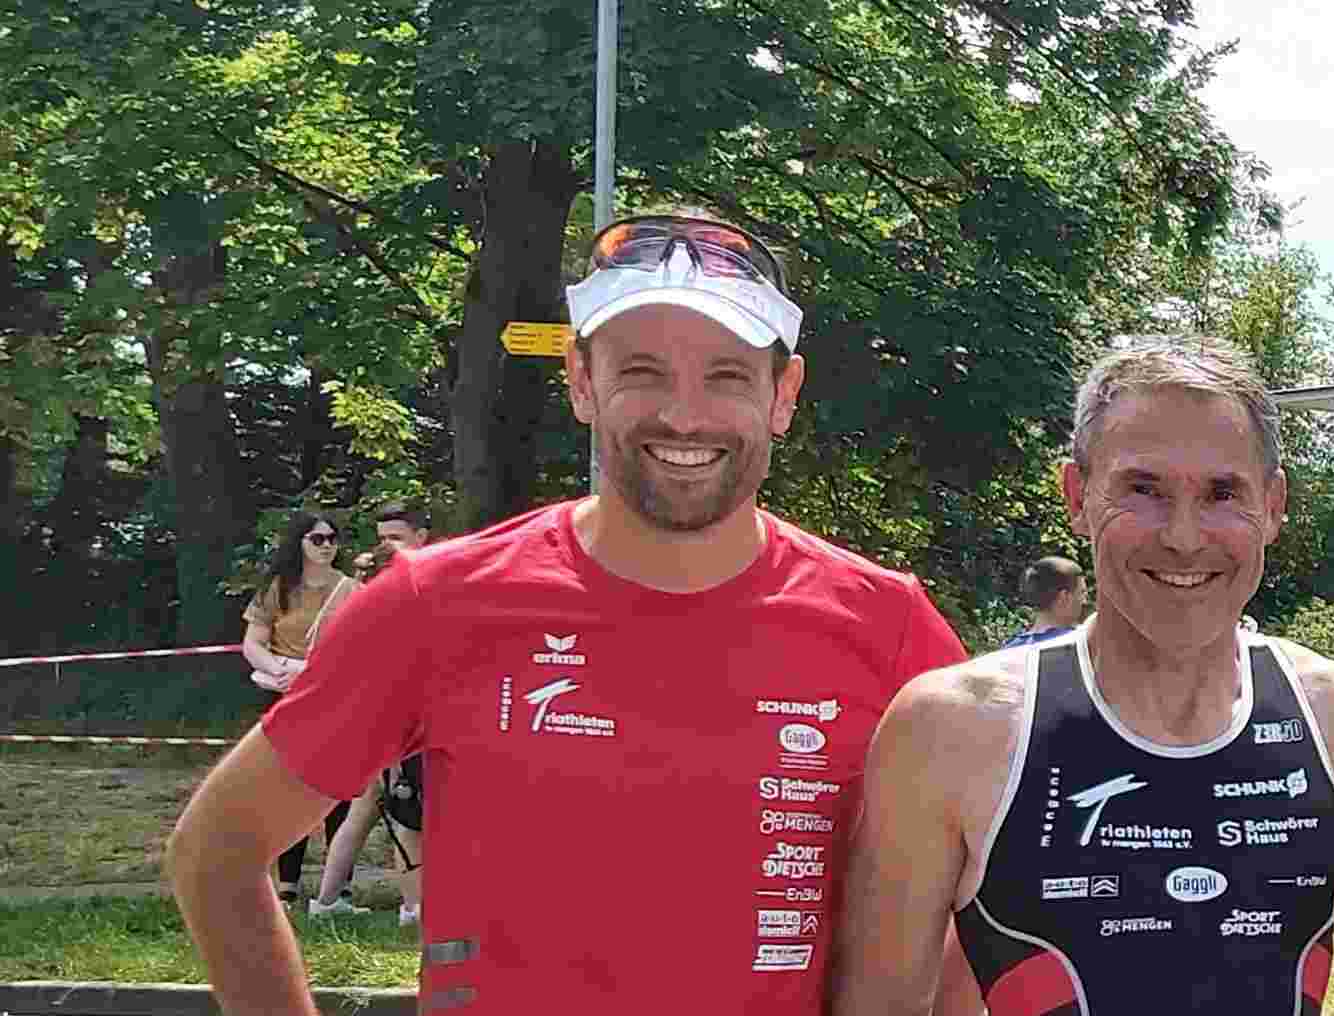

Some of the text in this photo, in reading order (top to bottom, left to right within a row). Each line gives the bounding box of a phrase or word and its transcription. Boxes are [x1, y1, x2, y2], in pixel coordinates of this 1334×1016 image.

[757, 700, 819, 715] SCHUNK
[1213, 778, 1288, 798] SCHUNK
[1243, 817, 1320, 832] Schwörer
[1245, 832, 1289, 845] Haus
[767, 842, 824, 860] SPORT
[1173, 874, 1217, 895] Gaggli
[1224, 909, 1281, 922] SPORT
